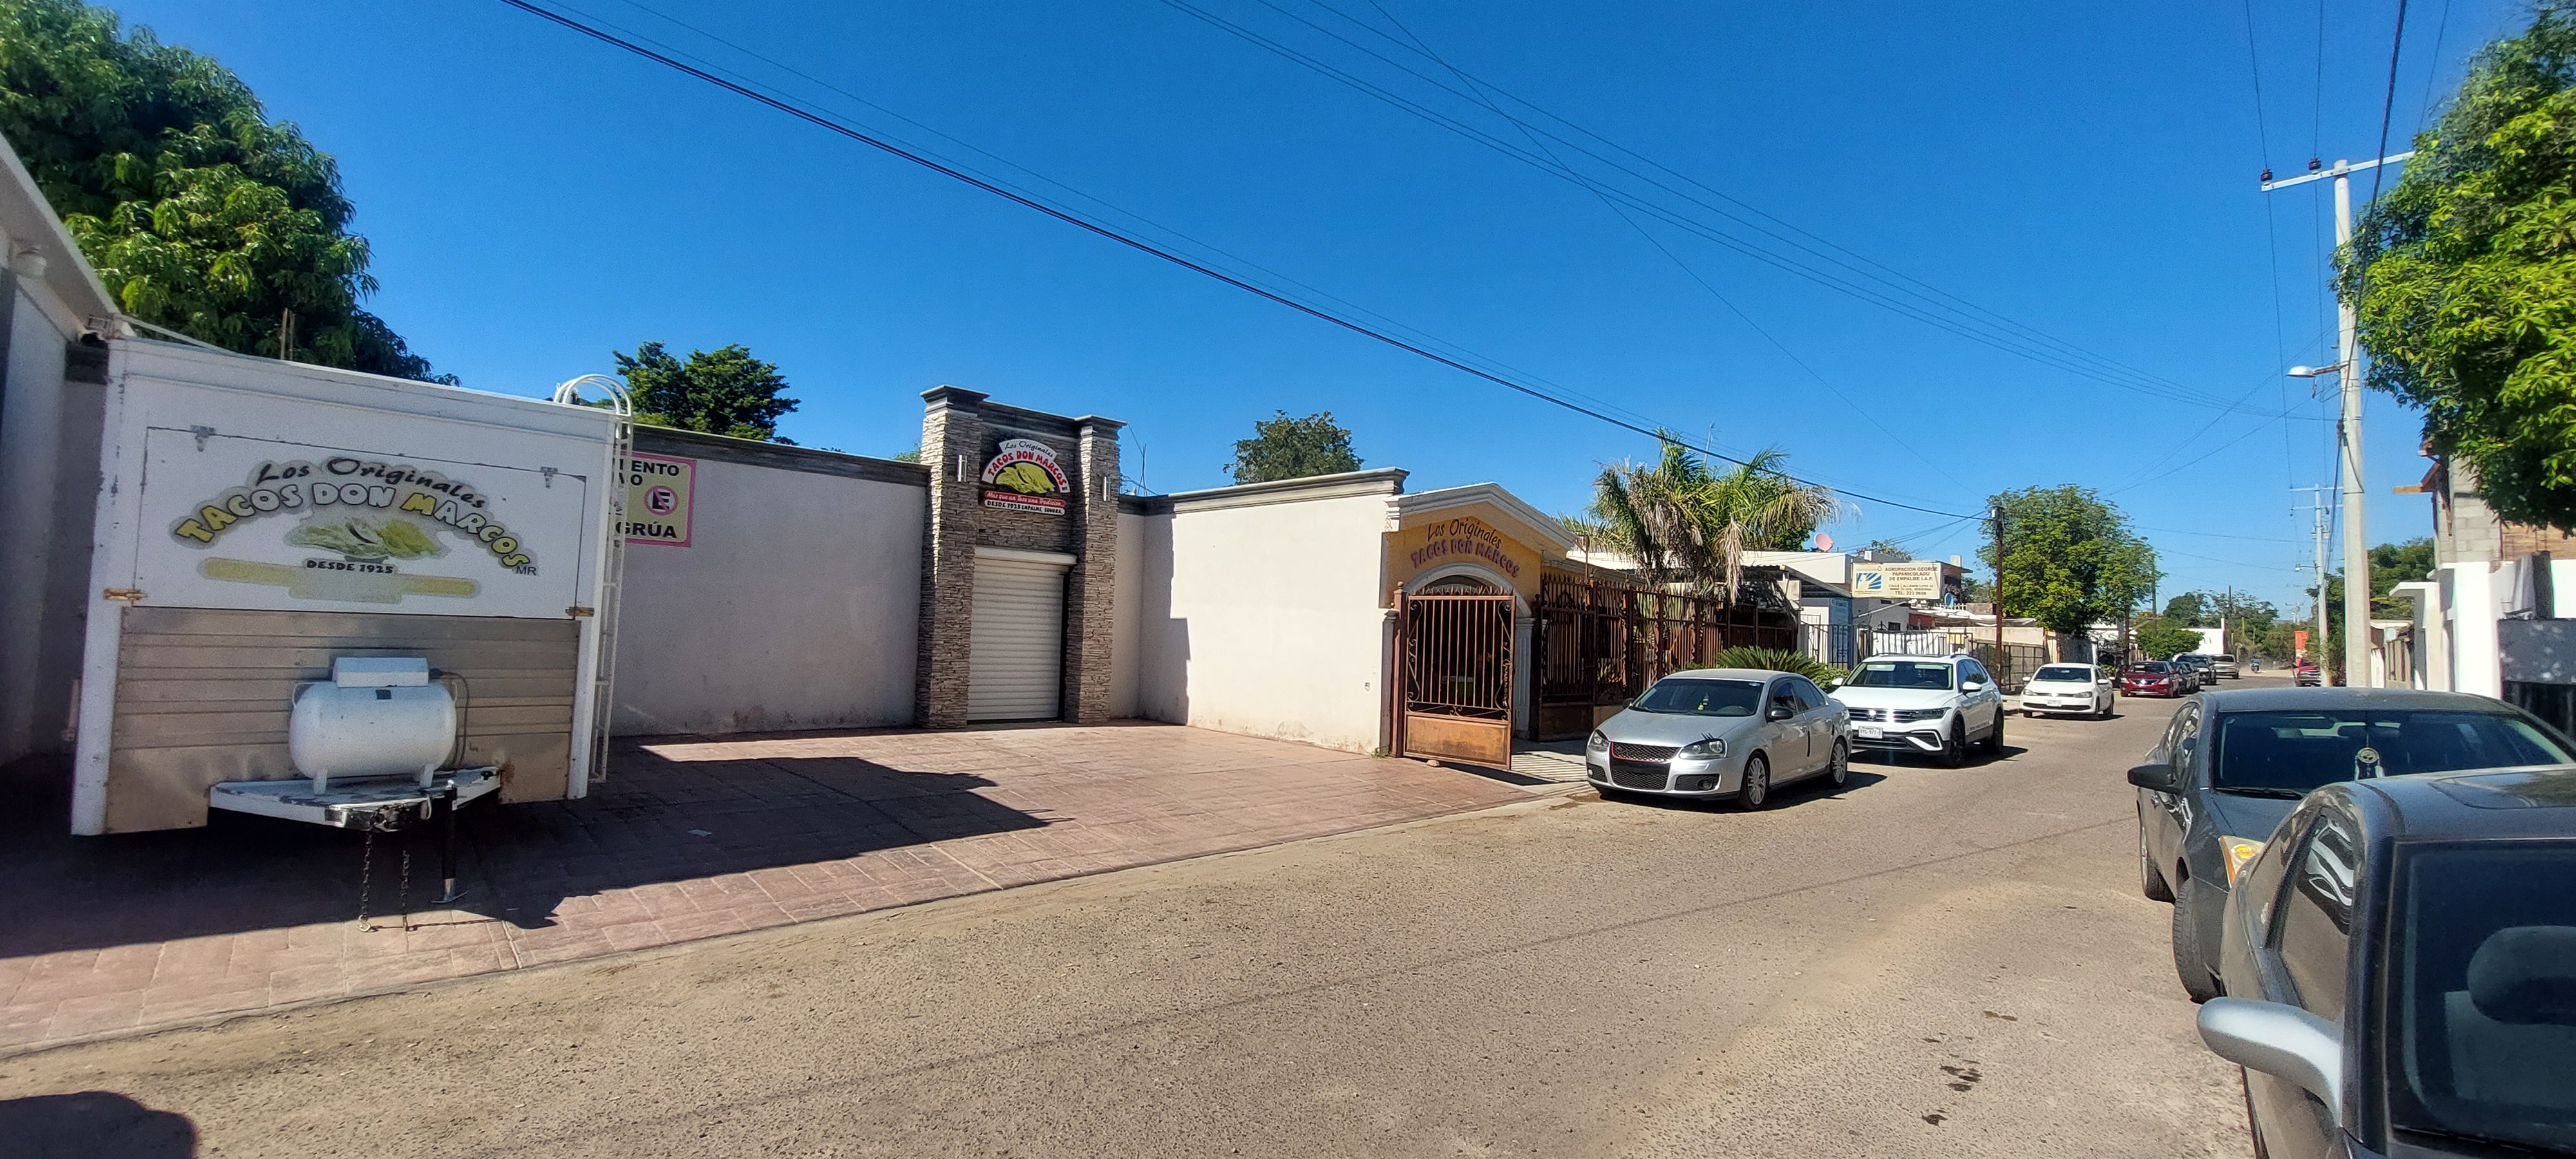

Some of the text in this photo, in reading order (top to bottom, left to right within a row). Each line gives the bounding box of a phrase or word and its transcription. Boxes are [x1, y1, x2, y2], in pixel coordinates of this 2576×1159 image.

[1019, 441, 1053, 458] Originales
[255, 457, 485, 509] Los Originales
[987, 451, 1067, 485] TACOS DON MARCOS
[175, 483, 531, 567] TACOS DON MARCOS
[615, 521, 677, 539] GRÚA
[1427, 518, 1502, 550] Los Originales
[306, 560, 394, 574] DESDE 1925
[516, 565, 537, 576] MR
[1410, 538, 1520, 578] TACOS DON MARCOS
